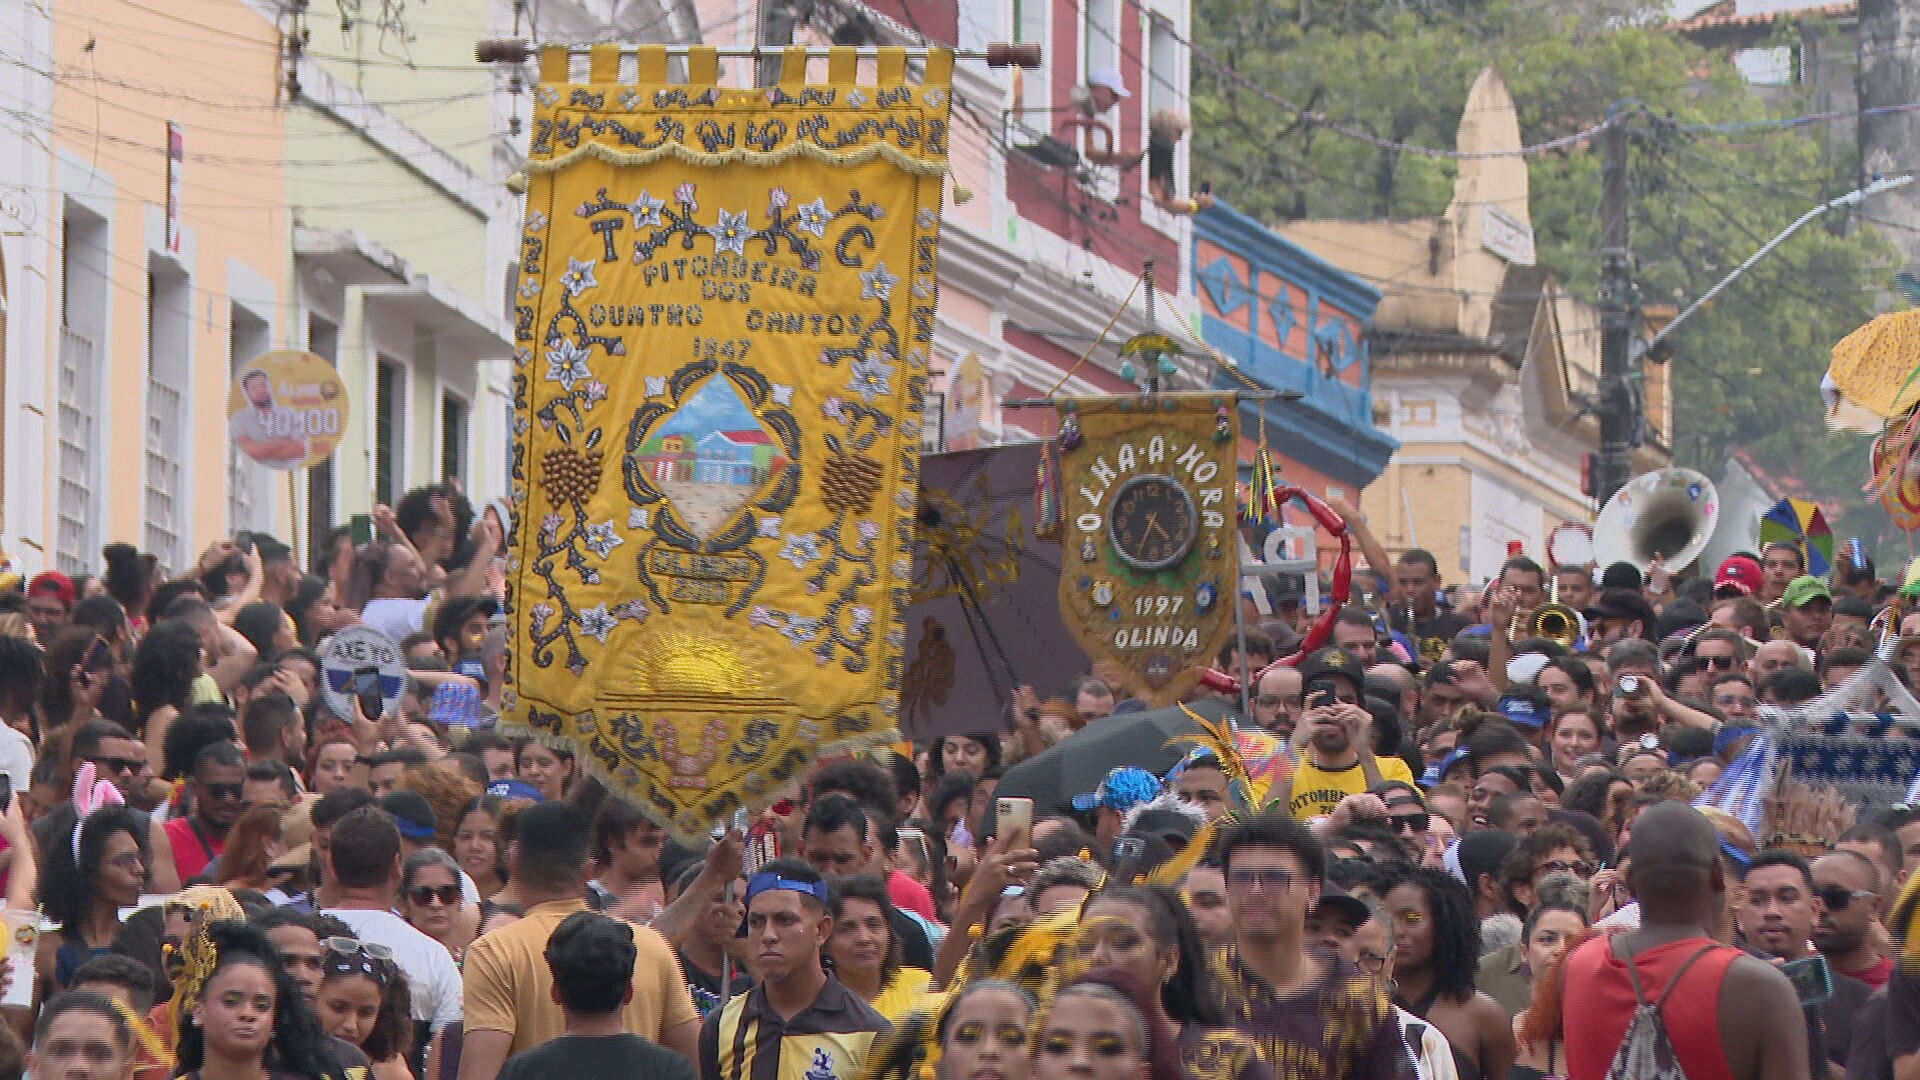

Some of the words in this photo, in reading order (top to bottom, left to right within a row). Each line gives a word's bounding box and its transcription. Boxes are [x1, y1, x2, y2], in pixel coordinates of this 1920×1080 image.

[591, 217, 624, 262] T
[835, 225, 875, 267] C
[643, 255, 818, 298] PITOMBEIRA
[702, 279, 752, 303] DOS
[746, 309, 865, 337] CANTOS
[1134, 595, 1185, 615] 1997
[1114, 627, 1199, 649] OLINDA
